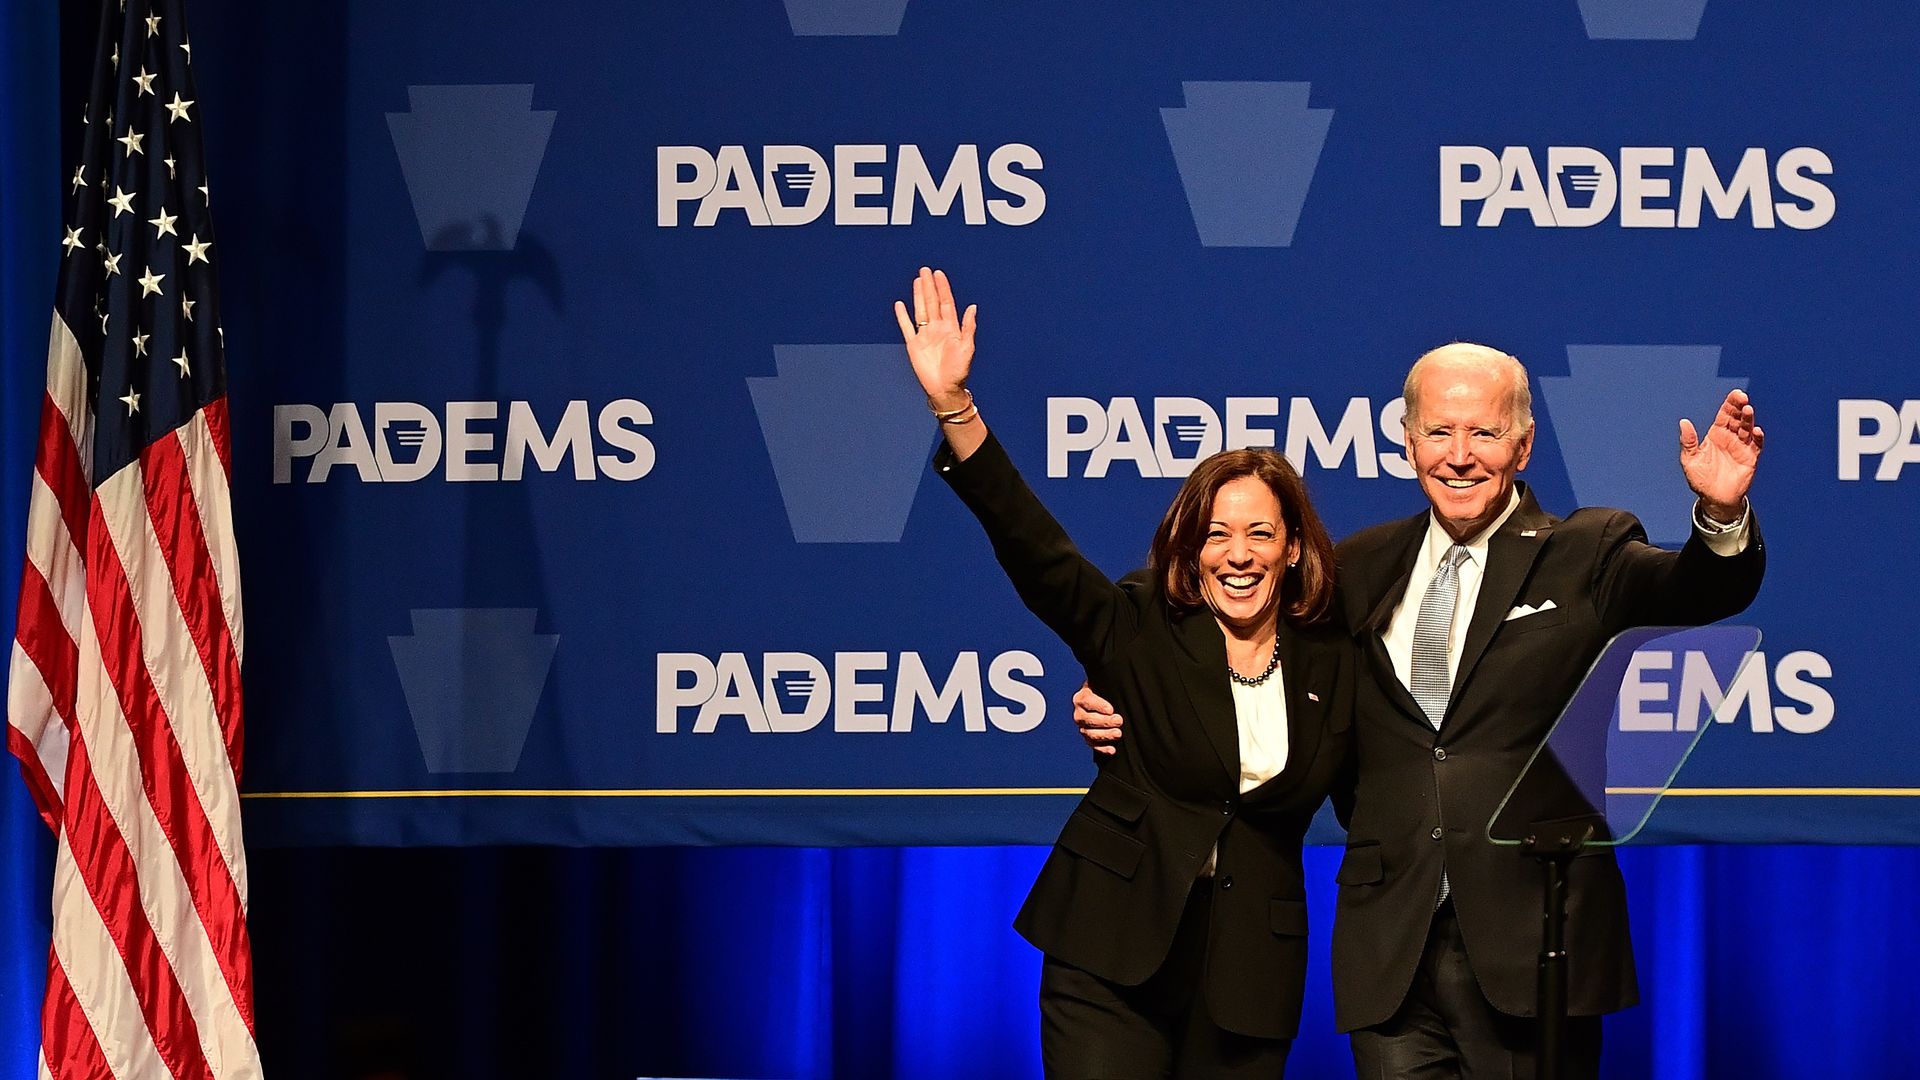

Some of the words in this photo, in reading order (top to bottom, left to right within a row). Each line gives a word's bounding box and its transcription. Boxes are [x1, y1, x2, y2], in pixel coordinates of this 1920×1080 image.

[657, 143, 1047, 228] PADEMS
[1440, 146, 1836, 230] PADEMS
[273, 398, 656, 484] PADEMS
[656, 650, 1047, 734] PADEMS
[1618, 650, 1835, 734] EMS
